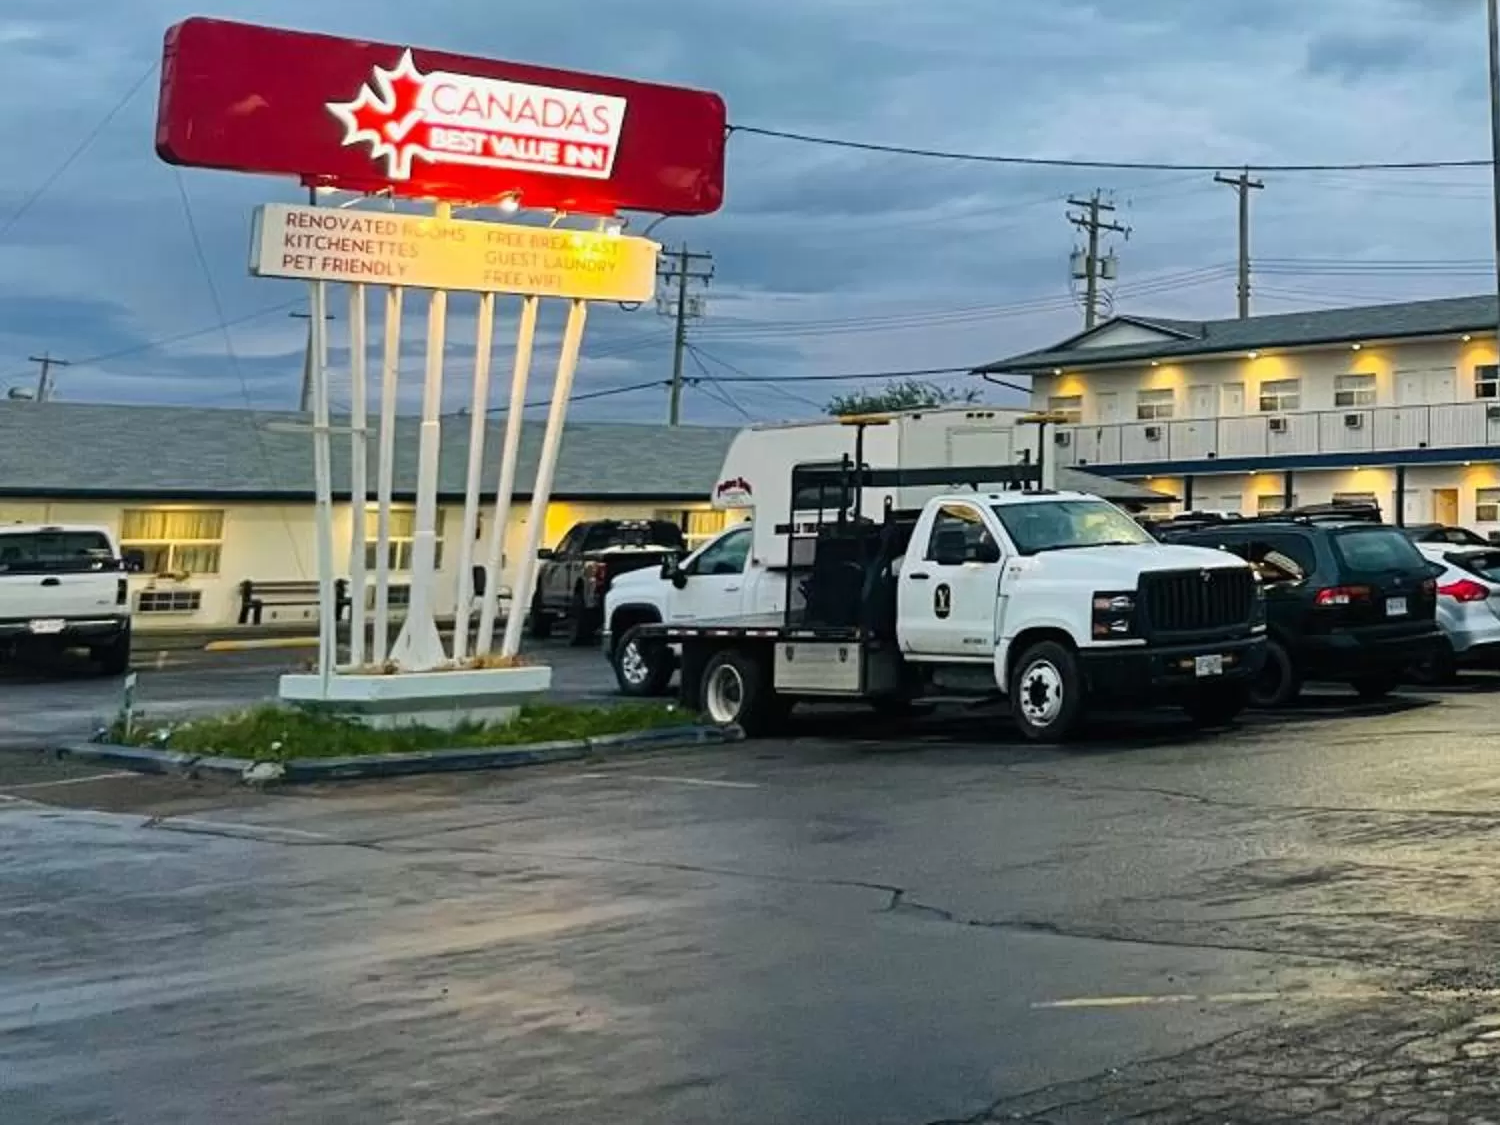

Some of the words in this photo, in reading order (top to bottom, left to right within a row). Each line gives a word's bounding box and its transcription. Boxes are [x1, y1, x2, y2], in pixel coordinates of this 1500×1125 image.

[431, 83, 610, 135] CANADAS
[429, 127, 487, 155] BEST
[491, 135, 560, 163] VALUE
[564, 145, 605, 168] INN
[286, 212, 398, 236] RENOVATED
[284, 233, 419, 258] KITCHENETTES
[487, 231, 525, 247] FREE
[282, 254, 320, 271] PET
[321, 257, 409, 276] FRIENDLY
[484, 251, 538, 267] GUEST
[543, 255, 617, 272] LAUNDRY
[483, 270, 523, 286] FREE
